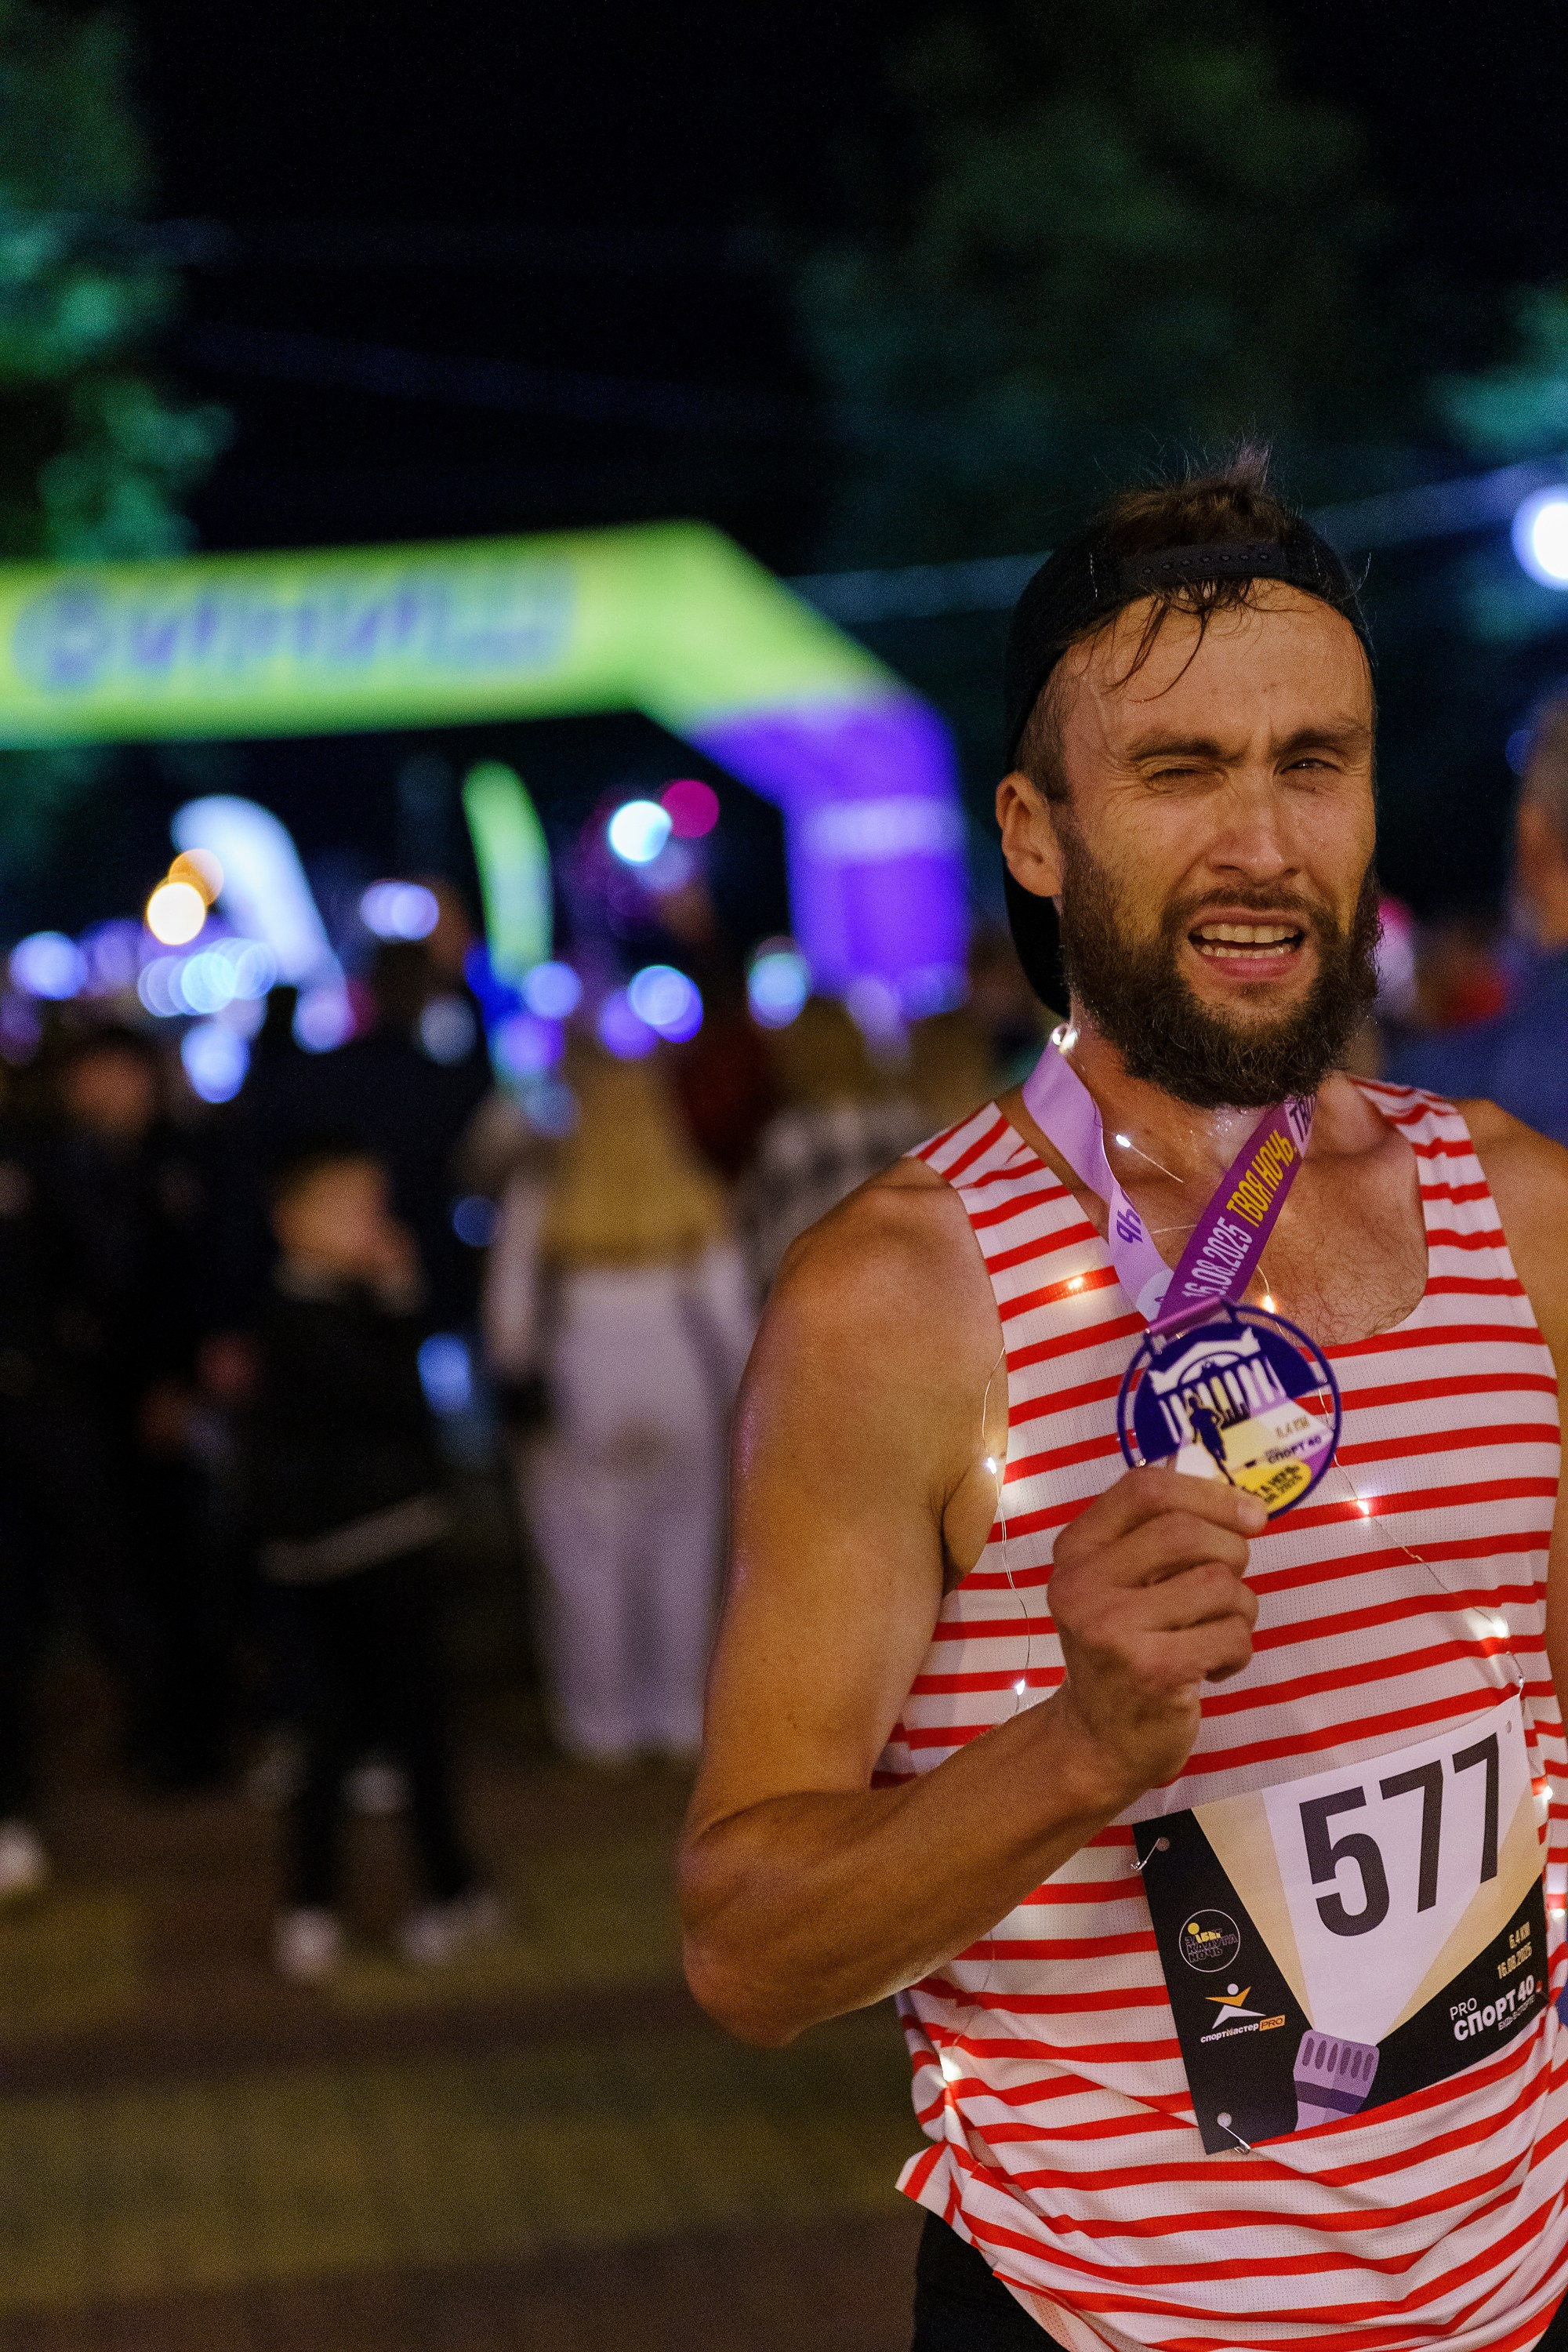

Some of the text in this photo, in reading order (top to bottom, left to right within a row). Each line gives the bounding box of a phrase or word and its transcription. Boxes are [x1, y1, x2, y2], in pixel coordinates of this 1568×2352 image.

[1226, 1168, 1274, 1228] ТВОЯ
[1298, 1731, 1500, 1937] 577
[1261, 2016, 1283, 2031] PRO
[1450, 1998, 1477, 2020] PRO
[1454, 1975, 1535, 2042] СПОРТ 40
